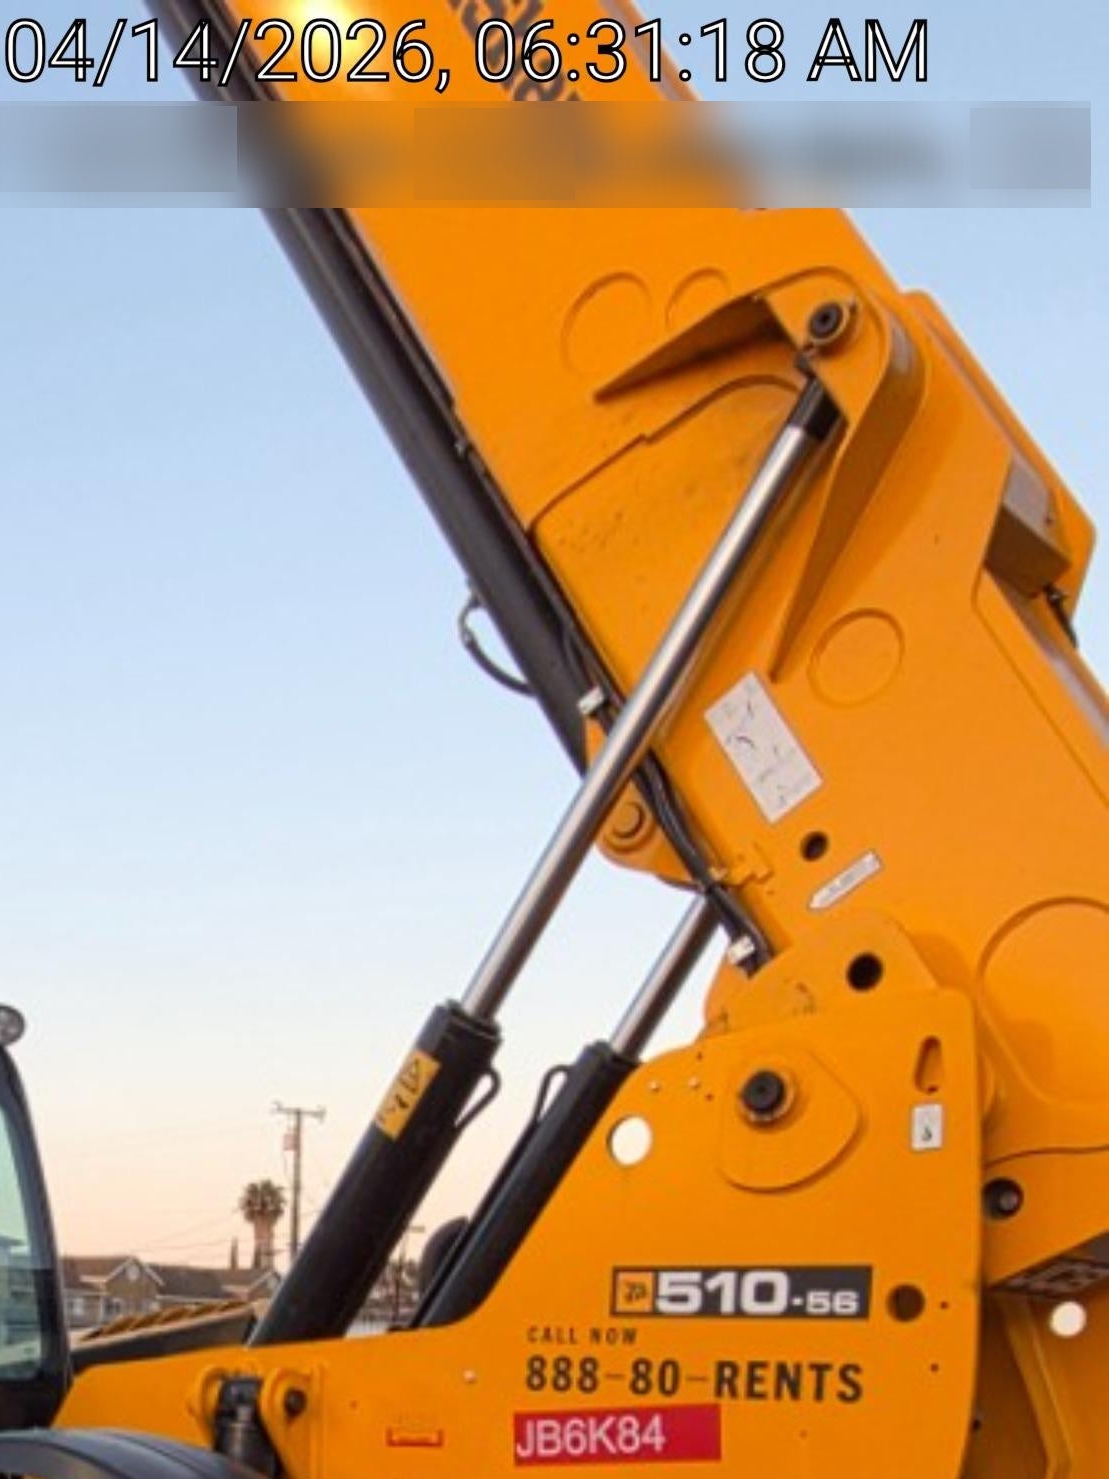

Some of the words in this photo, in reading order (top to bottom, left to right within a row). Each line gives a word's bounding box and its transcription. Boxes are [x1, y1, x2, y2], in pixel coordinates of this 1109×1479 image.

[526, 1326, 579, 1345] CALL
[589, 1327, 638, 1346] NOW
[525, 1354, 865, 1404] 888-80-RENTS
[515, 1413, 667, 1459] JB6K84
